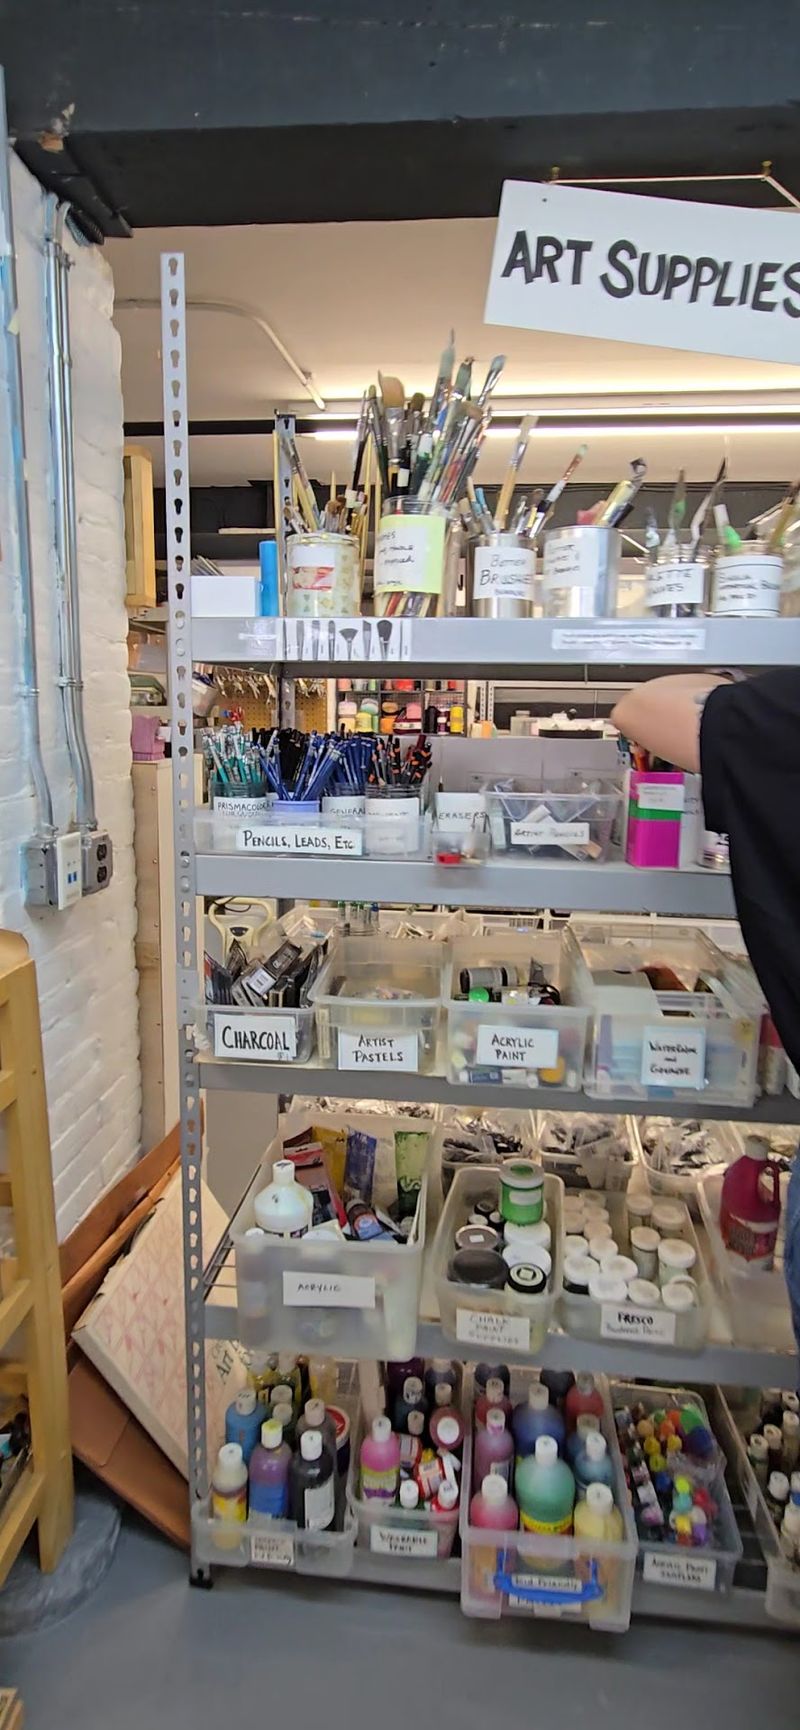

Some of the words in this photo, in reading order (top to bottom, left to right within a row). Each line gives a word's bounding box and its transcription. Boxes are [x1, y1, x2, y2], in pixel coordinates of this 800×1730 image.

[501, 229, 592, 284] ART
[599, 238, 800, 318] SUPPLIES
[479, 569, 534, 586] BRUSHE
[437, 810, 485, 821] ERASERS
[243, 829, 291, 849] PENCILS,
[295, 834, 331, 850] LEADS,
[222, 1025, 289, 1051] CHARCOAL
[357, 1034, 395, 1049] ARTIST
[491, 1033, 535, 1048] ACRYLIC
[352, 1050, 403, 1063] PASTELS
[495, 1048, 528, 1062] PAINT
[296, 1283, 341, 1294] ACRYLIC
[469, 1314, 508, 1326] CHALK
[617, 1312, 654, 1326] FRESCO
